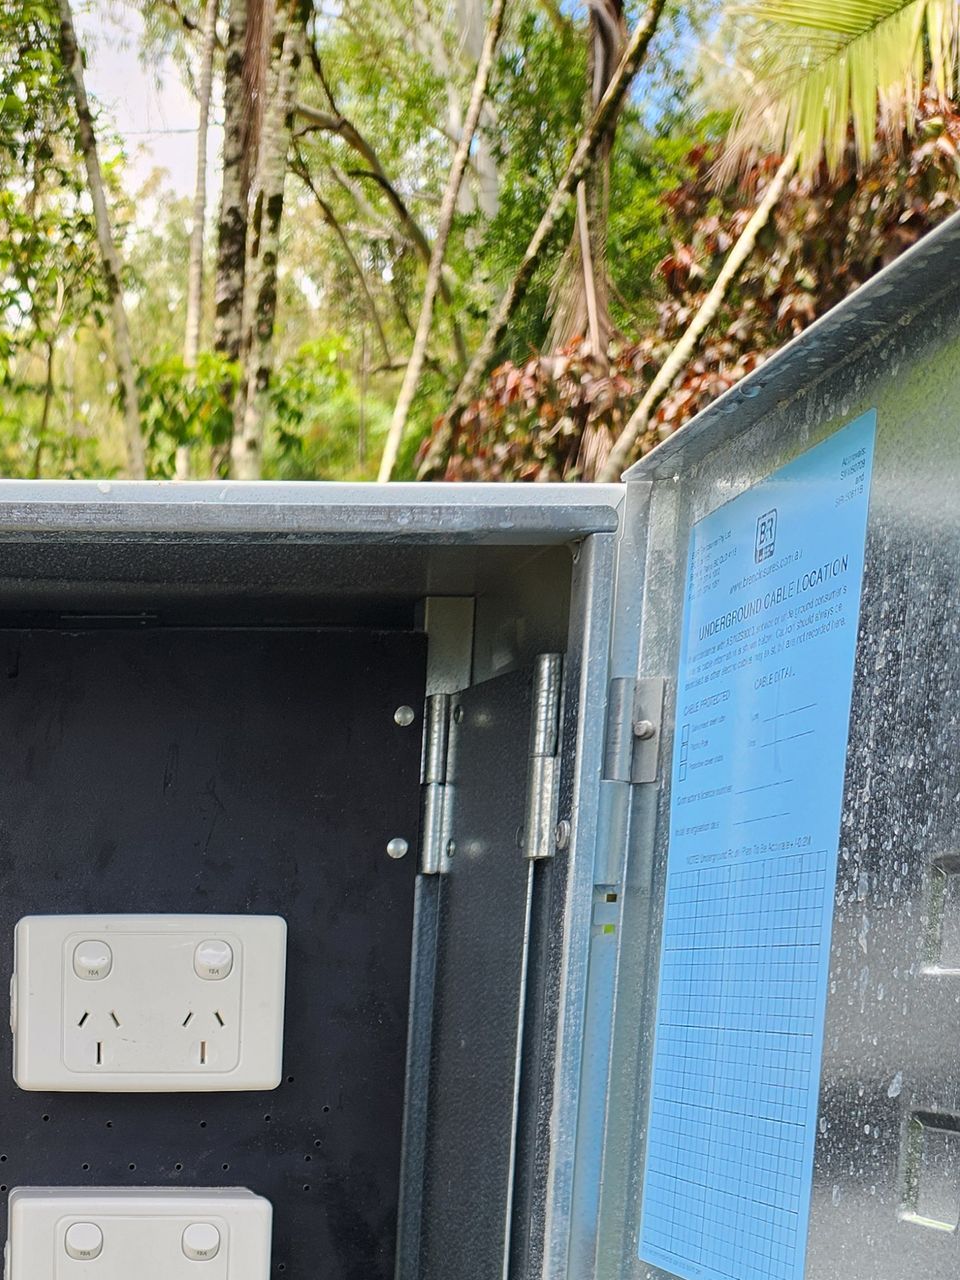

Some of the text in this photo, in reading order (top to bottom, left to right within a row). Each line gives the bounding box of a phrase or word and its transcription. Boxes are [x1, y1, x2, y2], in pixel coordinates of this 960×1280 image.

[698, 598, 762, 641] UNDERGROUND
[763, 581, 794, 610] CABLE
[796, 554, 849, 595] LOCATION
